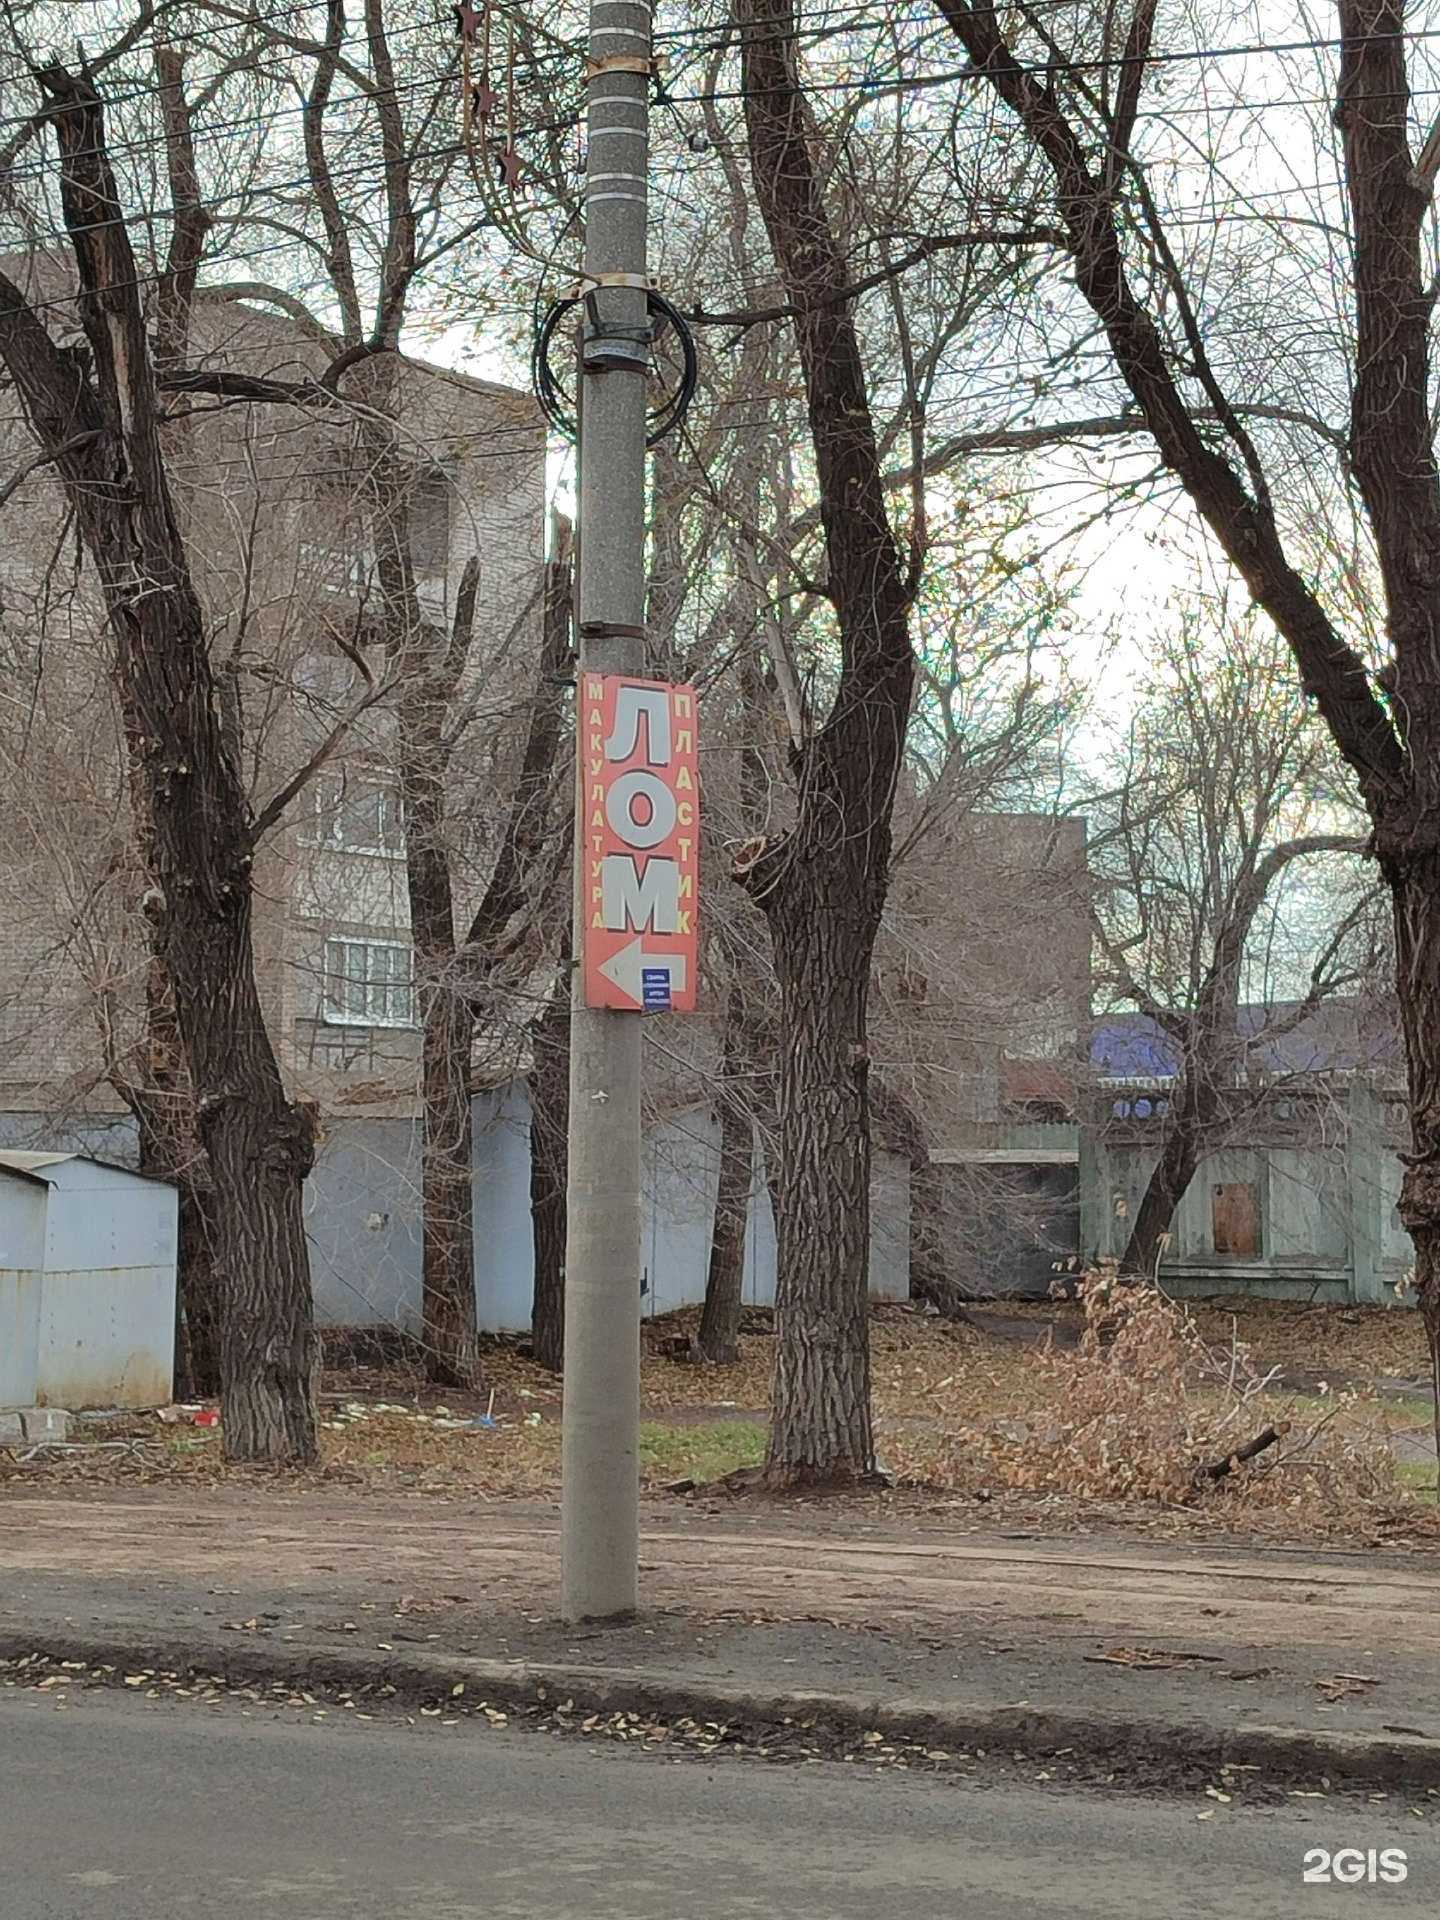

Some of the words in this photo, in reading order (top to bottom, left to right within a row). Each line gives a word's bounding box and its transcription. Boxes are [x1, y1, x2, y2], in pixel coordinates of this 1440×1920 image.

[588, 682, 605, 929] МАКУЛАТУРА
[604, 684, 679, 935] ЛОМ
[674, 693, 693, 935] ПЛАСТИК
